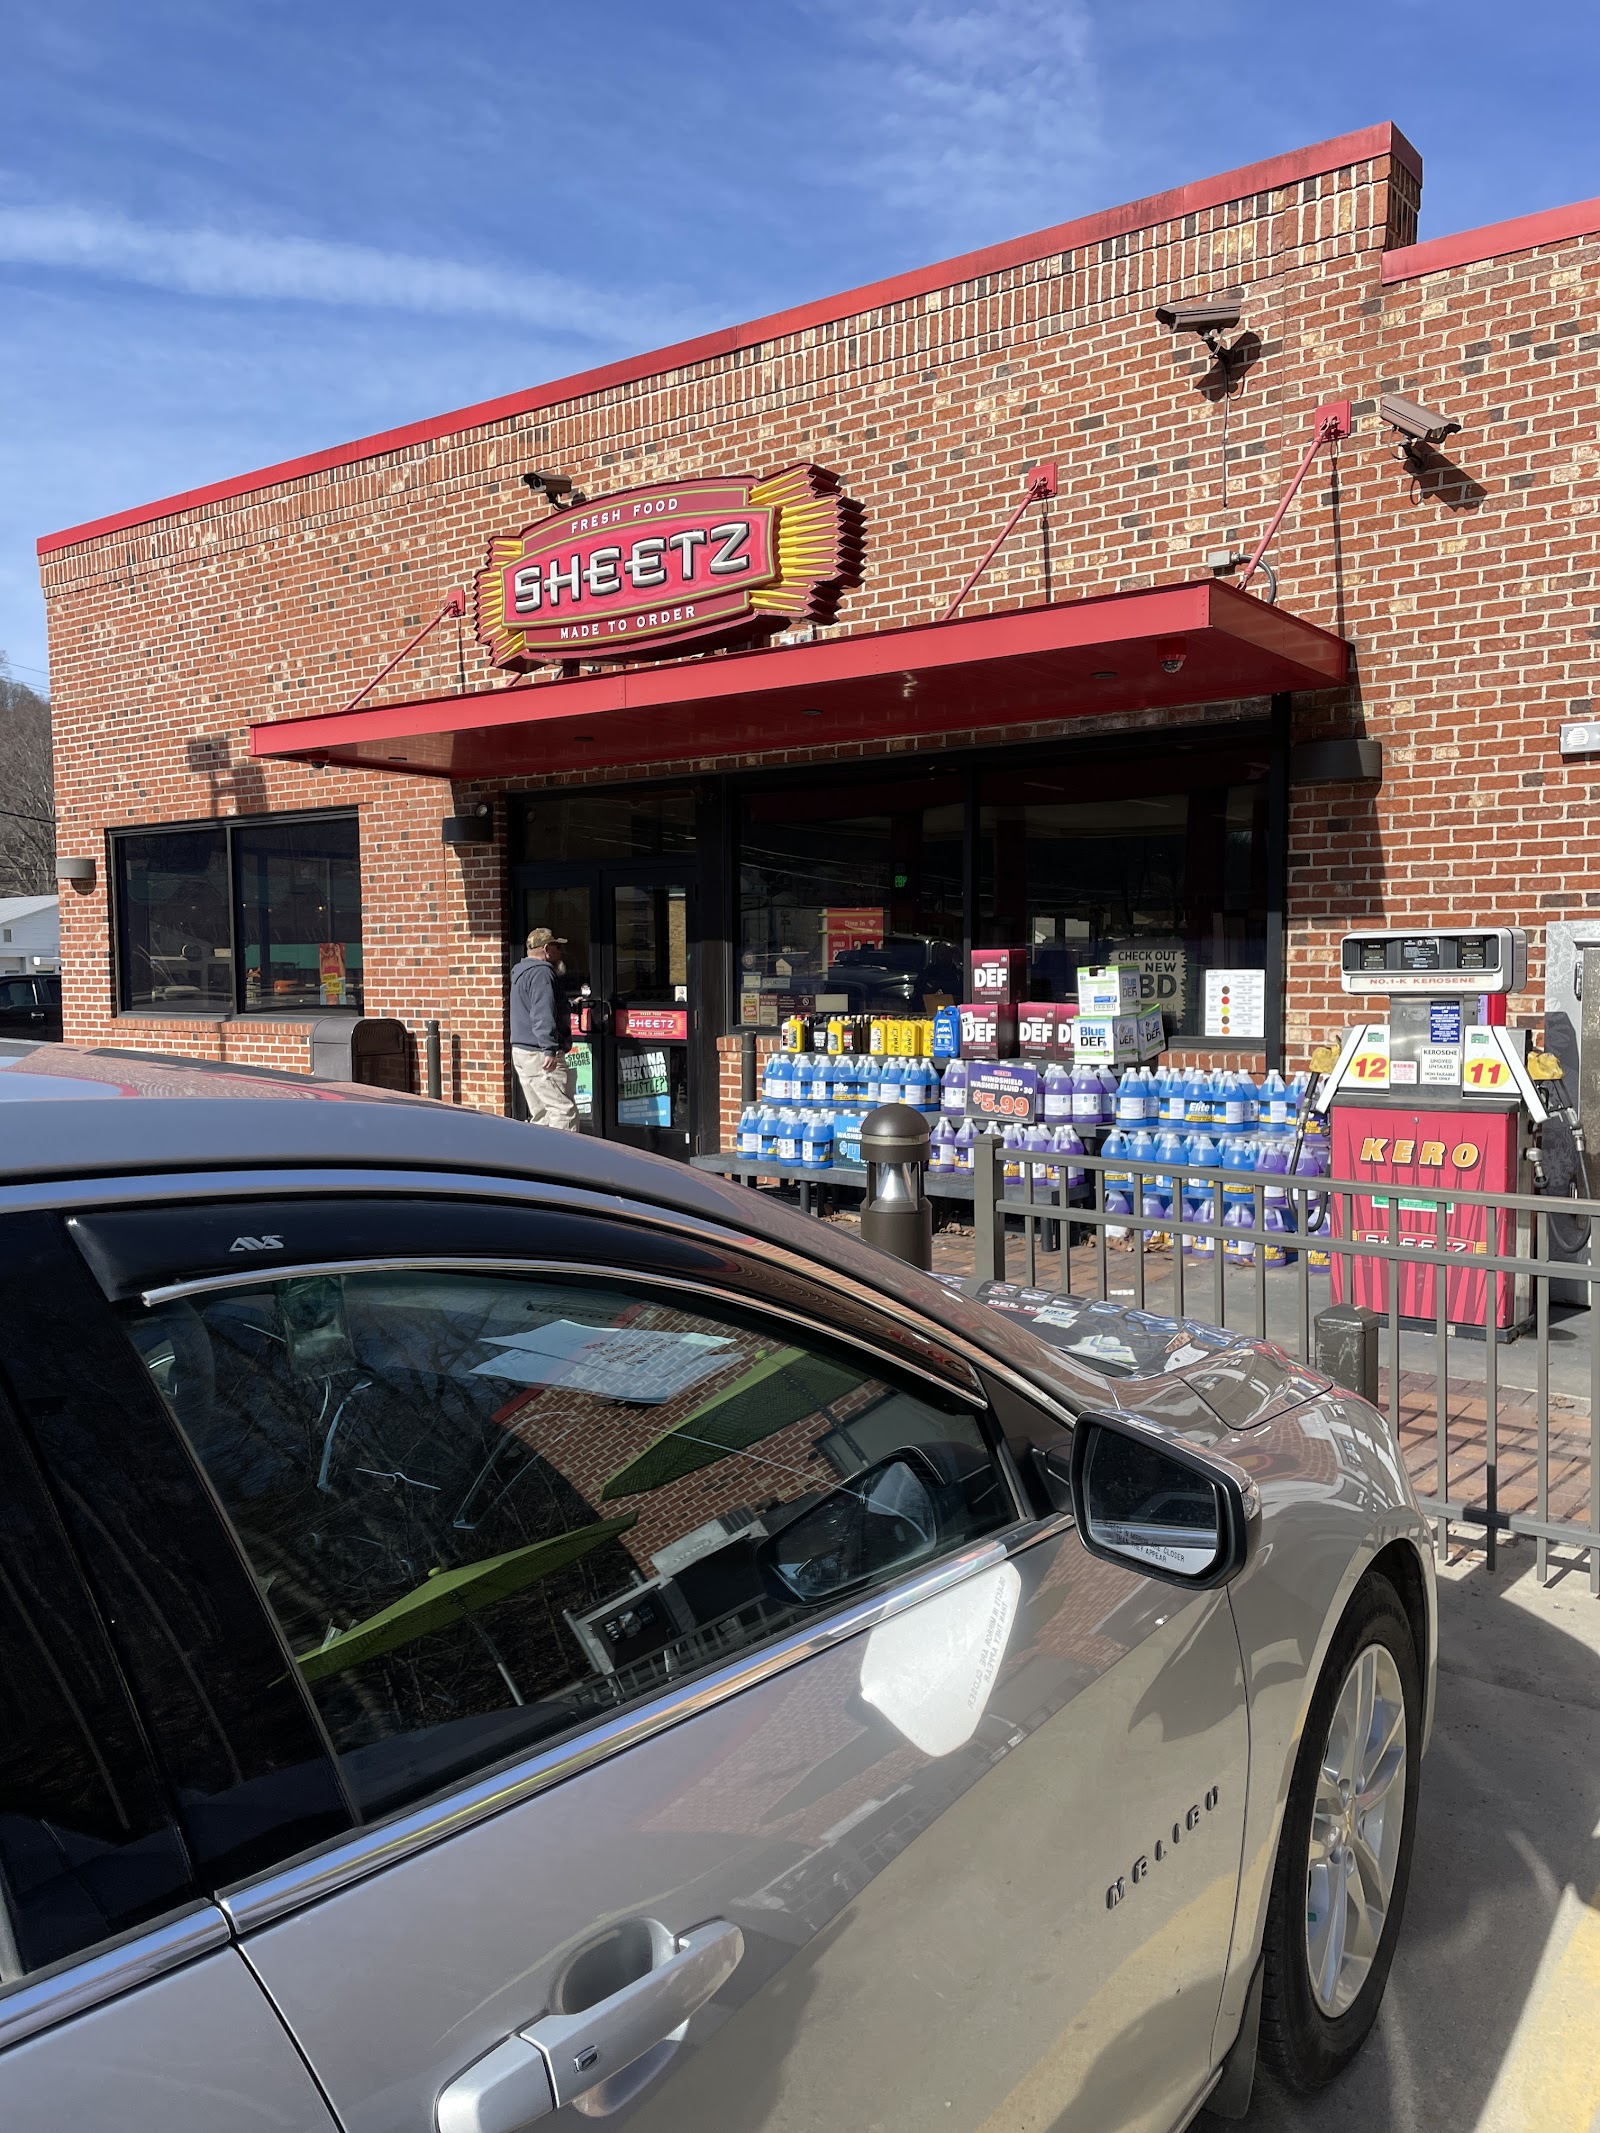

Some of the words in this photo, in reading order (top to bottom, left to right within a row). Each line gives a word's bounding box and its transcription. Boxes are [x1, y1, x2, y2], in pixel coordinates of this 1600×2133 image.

[571, 509, 621, 534] FRESH
[633, 498, 678, 517] FOOD
[514, 521, 750, 613] SHEETZ
[560, 625, 600, 640] MADE
[608, 620, 627, 633] TO
[636, 605, 696, 628] ORDER
[1118, 951, 1152, 961] CHECK
[1155, 951, 1178, 961] OUT
[1145, 962, 1177, 972] NEW
[974, 968, 1007, 988] DEF
[1122, 977, 1137, 987] Blue
[1140, 974, 1177, 999] BD
[628, 1019, 674, 1028] SHEETZ
[962, 1023, 997, 1042] DEF
[1019, 1022, 1053, 1043] DEF
[1080, 1027, 1106, 1036] Blue
[1080, 1037, 1106, 1047] DEF
[620, 1051, 665, 1069] WANNA
[1355, 1057, 1387, 1078] 12
[623, 1067, 643, 1081] FLEX
[643, 1063, 667, 1079] YOUR
[981, 1075, 1023, 1086] WINDSHIELD
[1470, 1063, 1501, 1085] 11
[624, 1077, 665, 1097] HUSTLE?
[833, 1082, 849, 1092] Elite
[970, 1080, 1000, 1090] WASHER
[1000, 1084, 1019, 1093] FLUID
[973, 1089, 1029, 1117] $5.99
[1189, 1100, 1210, 1112] Elite
[1359, 1137, 1479, 1168] KERO
[1145, 1548, 1167, 1563] APPEAR
[1163, 1547, 1185, 1562] CLOSER
